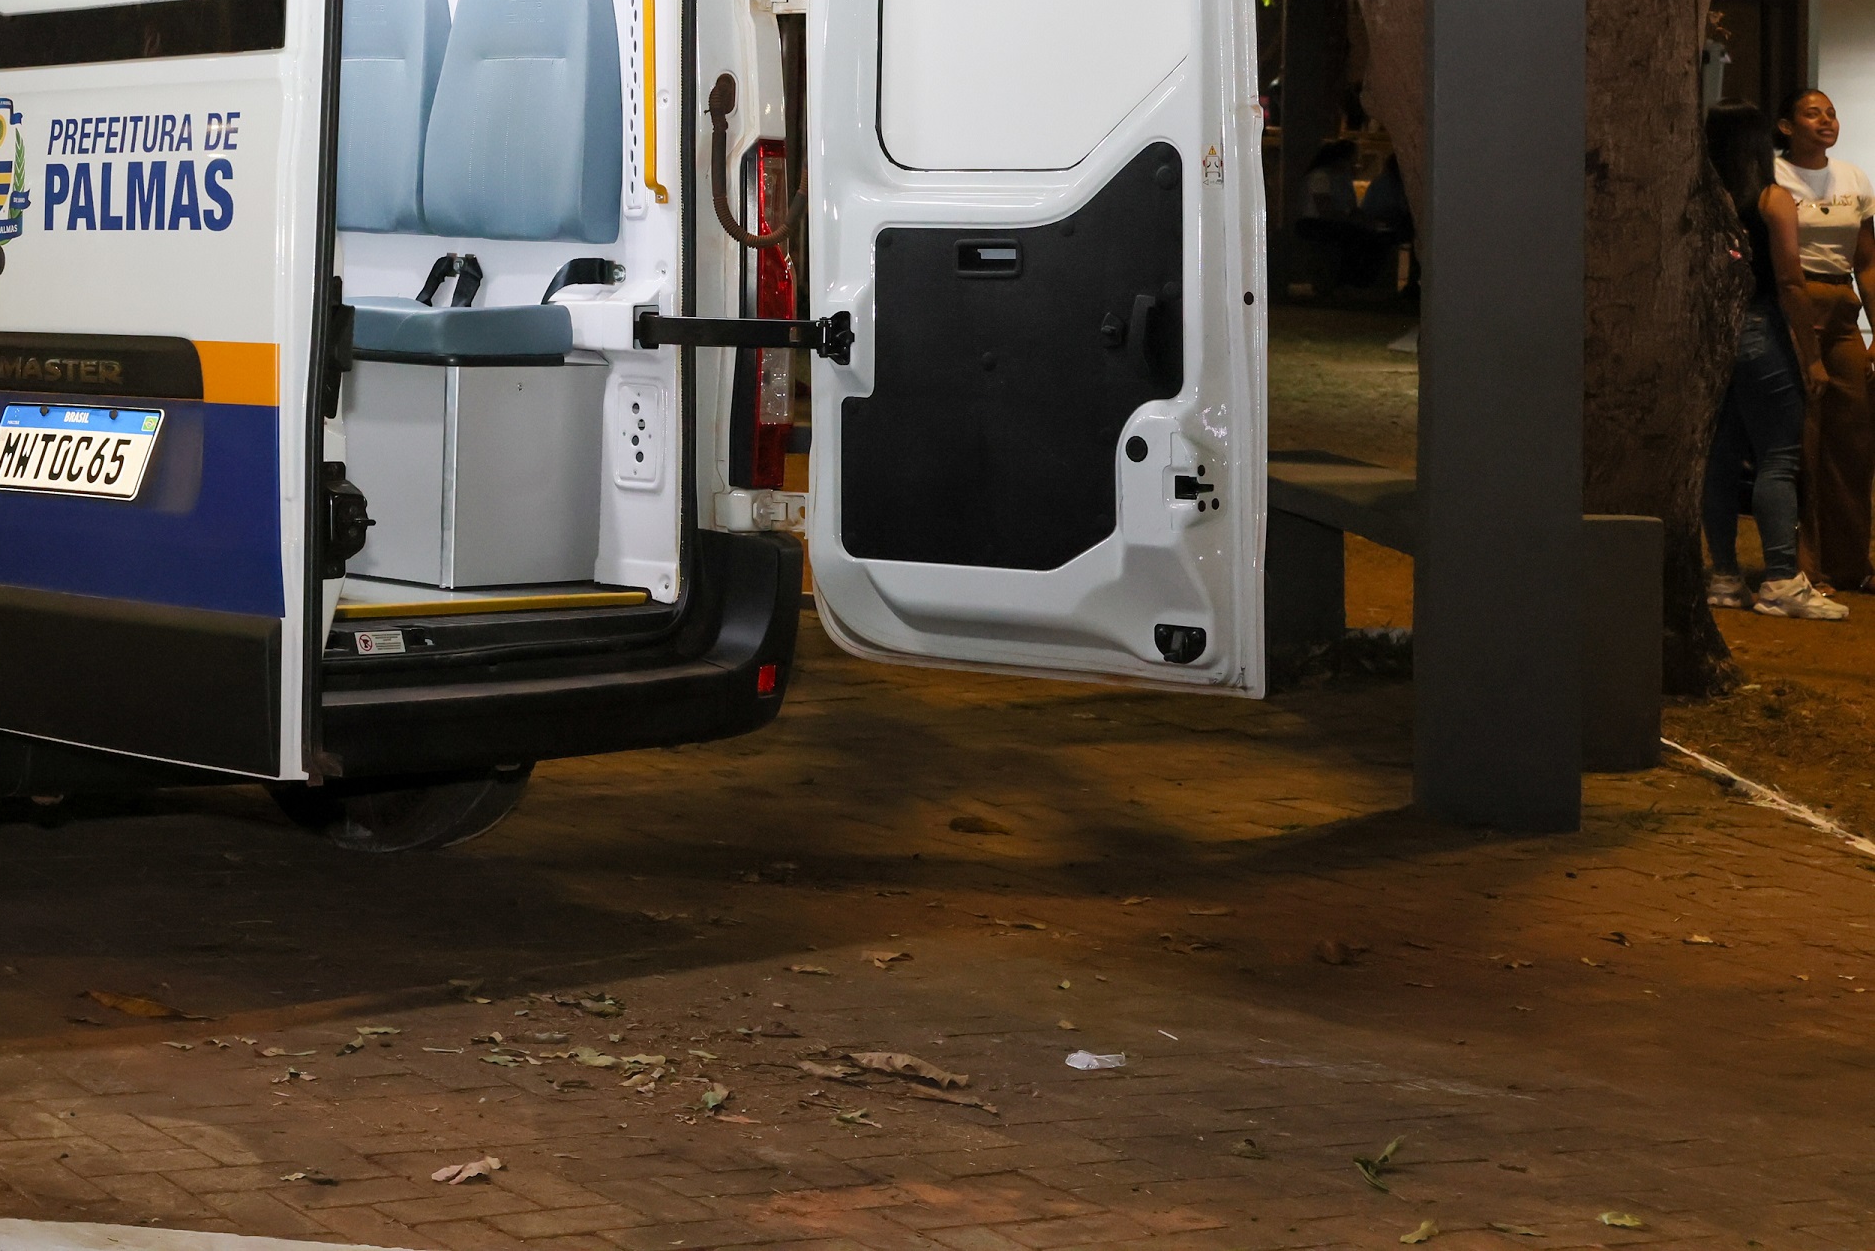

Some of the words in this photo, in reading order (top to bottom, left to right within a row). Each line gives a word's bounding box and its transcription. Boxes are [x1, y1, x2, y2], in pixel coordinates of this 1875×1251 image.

[47, 114, 193, 155] PREFEITURA
[204, 112, 241, 151] DE
[44, 158, 234, 232] PALMAS
[63, 411, 90, 424] BRASIL
